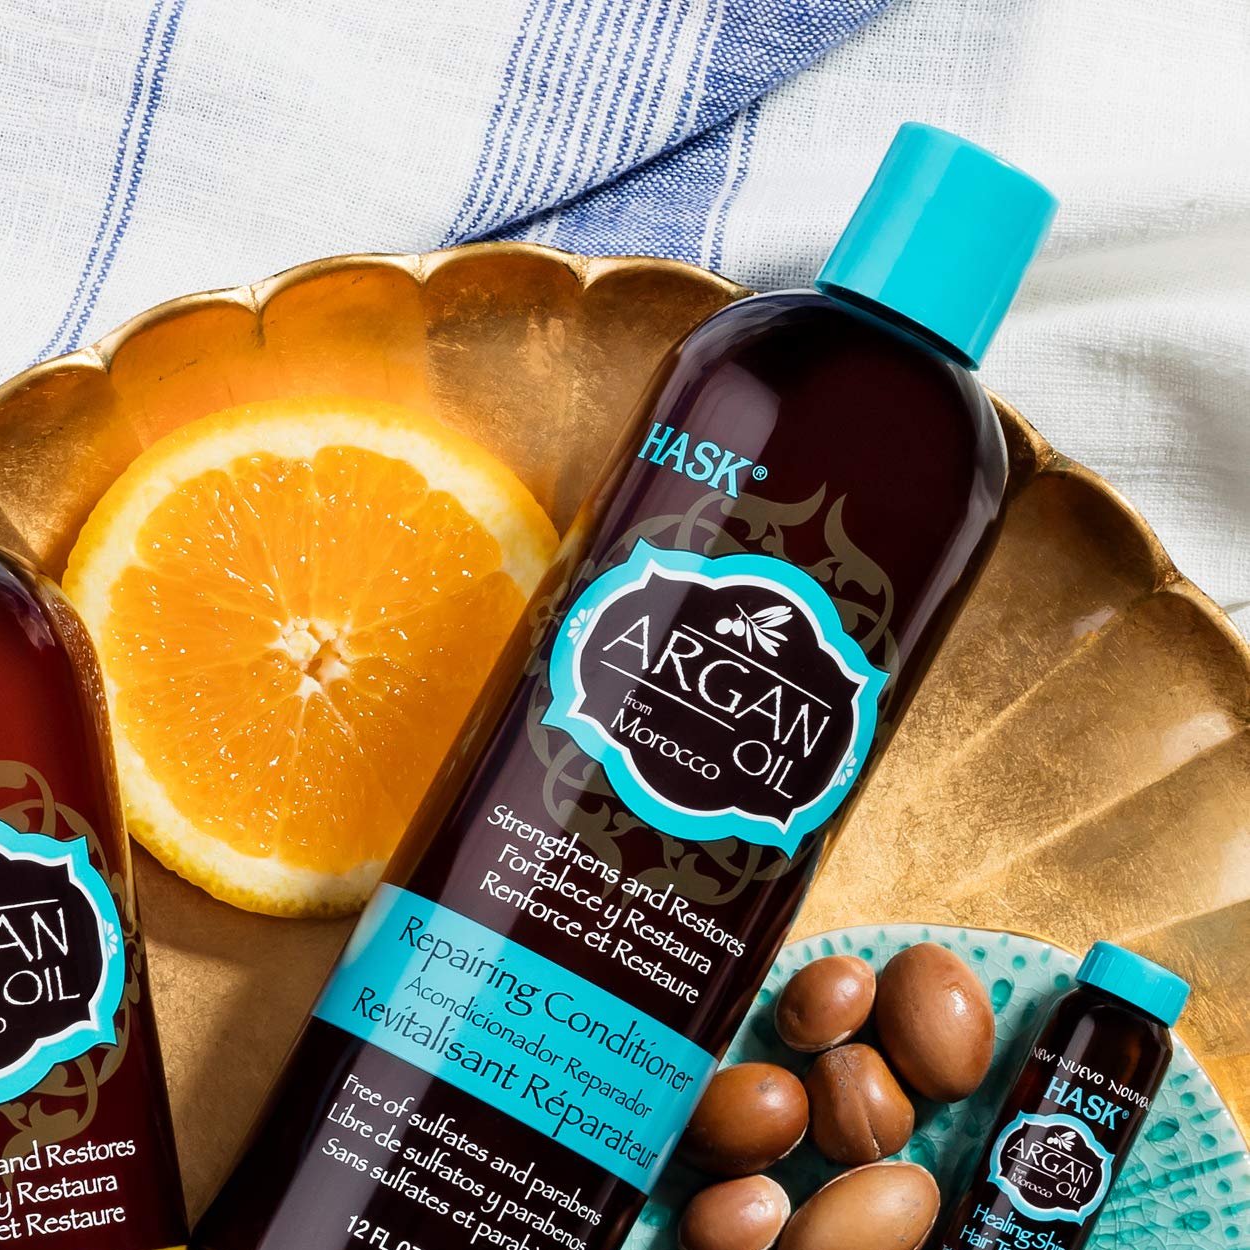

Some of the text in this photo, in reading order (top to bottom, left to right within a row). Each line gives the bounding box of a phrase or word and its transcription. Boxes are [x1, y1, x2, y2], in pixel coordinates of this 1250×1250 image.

[603, 615, 829, 757] ARGAN
[623, 690, 652, 715] from
[611, 708, 720, 779] Morocco
[733, 740, 793, 798] OIL
[487, 805, 745, 957] Strengthens and Restores
[498, 844, 711, 974] Fortalece Restaura
[480, 871, 698, 1003] Renforce et Restaure
[3, 966, 80, 1005] OIL
[399, 916, 693, 1092] Repairing Conditioner
[405, 976, 652, 1118] Acondicionador Reparador
[1033, 1046, 1104, 1085] NEW NUEVO
[352, 987, 658, 1169] Revitalisant Réparateur
[46, 1140, 135, 1167] Restores
[322, 1138, 368, 1171] Sans
[370, 1167, 450, 1214] sulfates
[328, 1103, 373, 1137] Libre
[375, 1125, 401, 1152] de
[403, 1148, 485, 1196] sulfatos
[343, 1074, 601, 1225] Free of sulfates and parabens
[1007, 1137, 1094, 1188] ARGAN
[17, 1176, 117, 1204] Restaura
[1010, 1172, 1053, 1199] Morocco
[1055, 1181, 1081, 1204] OIL
[26, 1207, 125, 1236] Restaure
[347, 1216, 370, 1239] 12
[959, 1224, 994, 1250] Hair
[972, 1203, 1036, 1250] Healing
